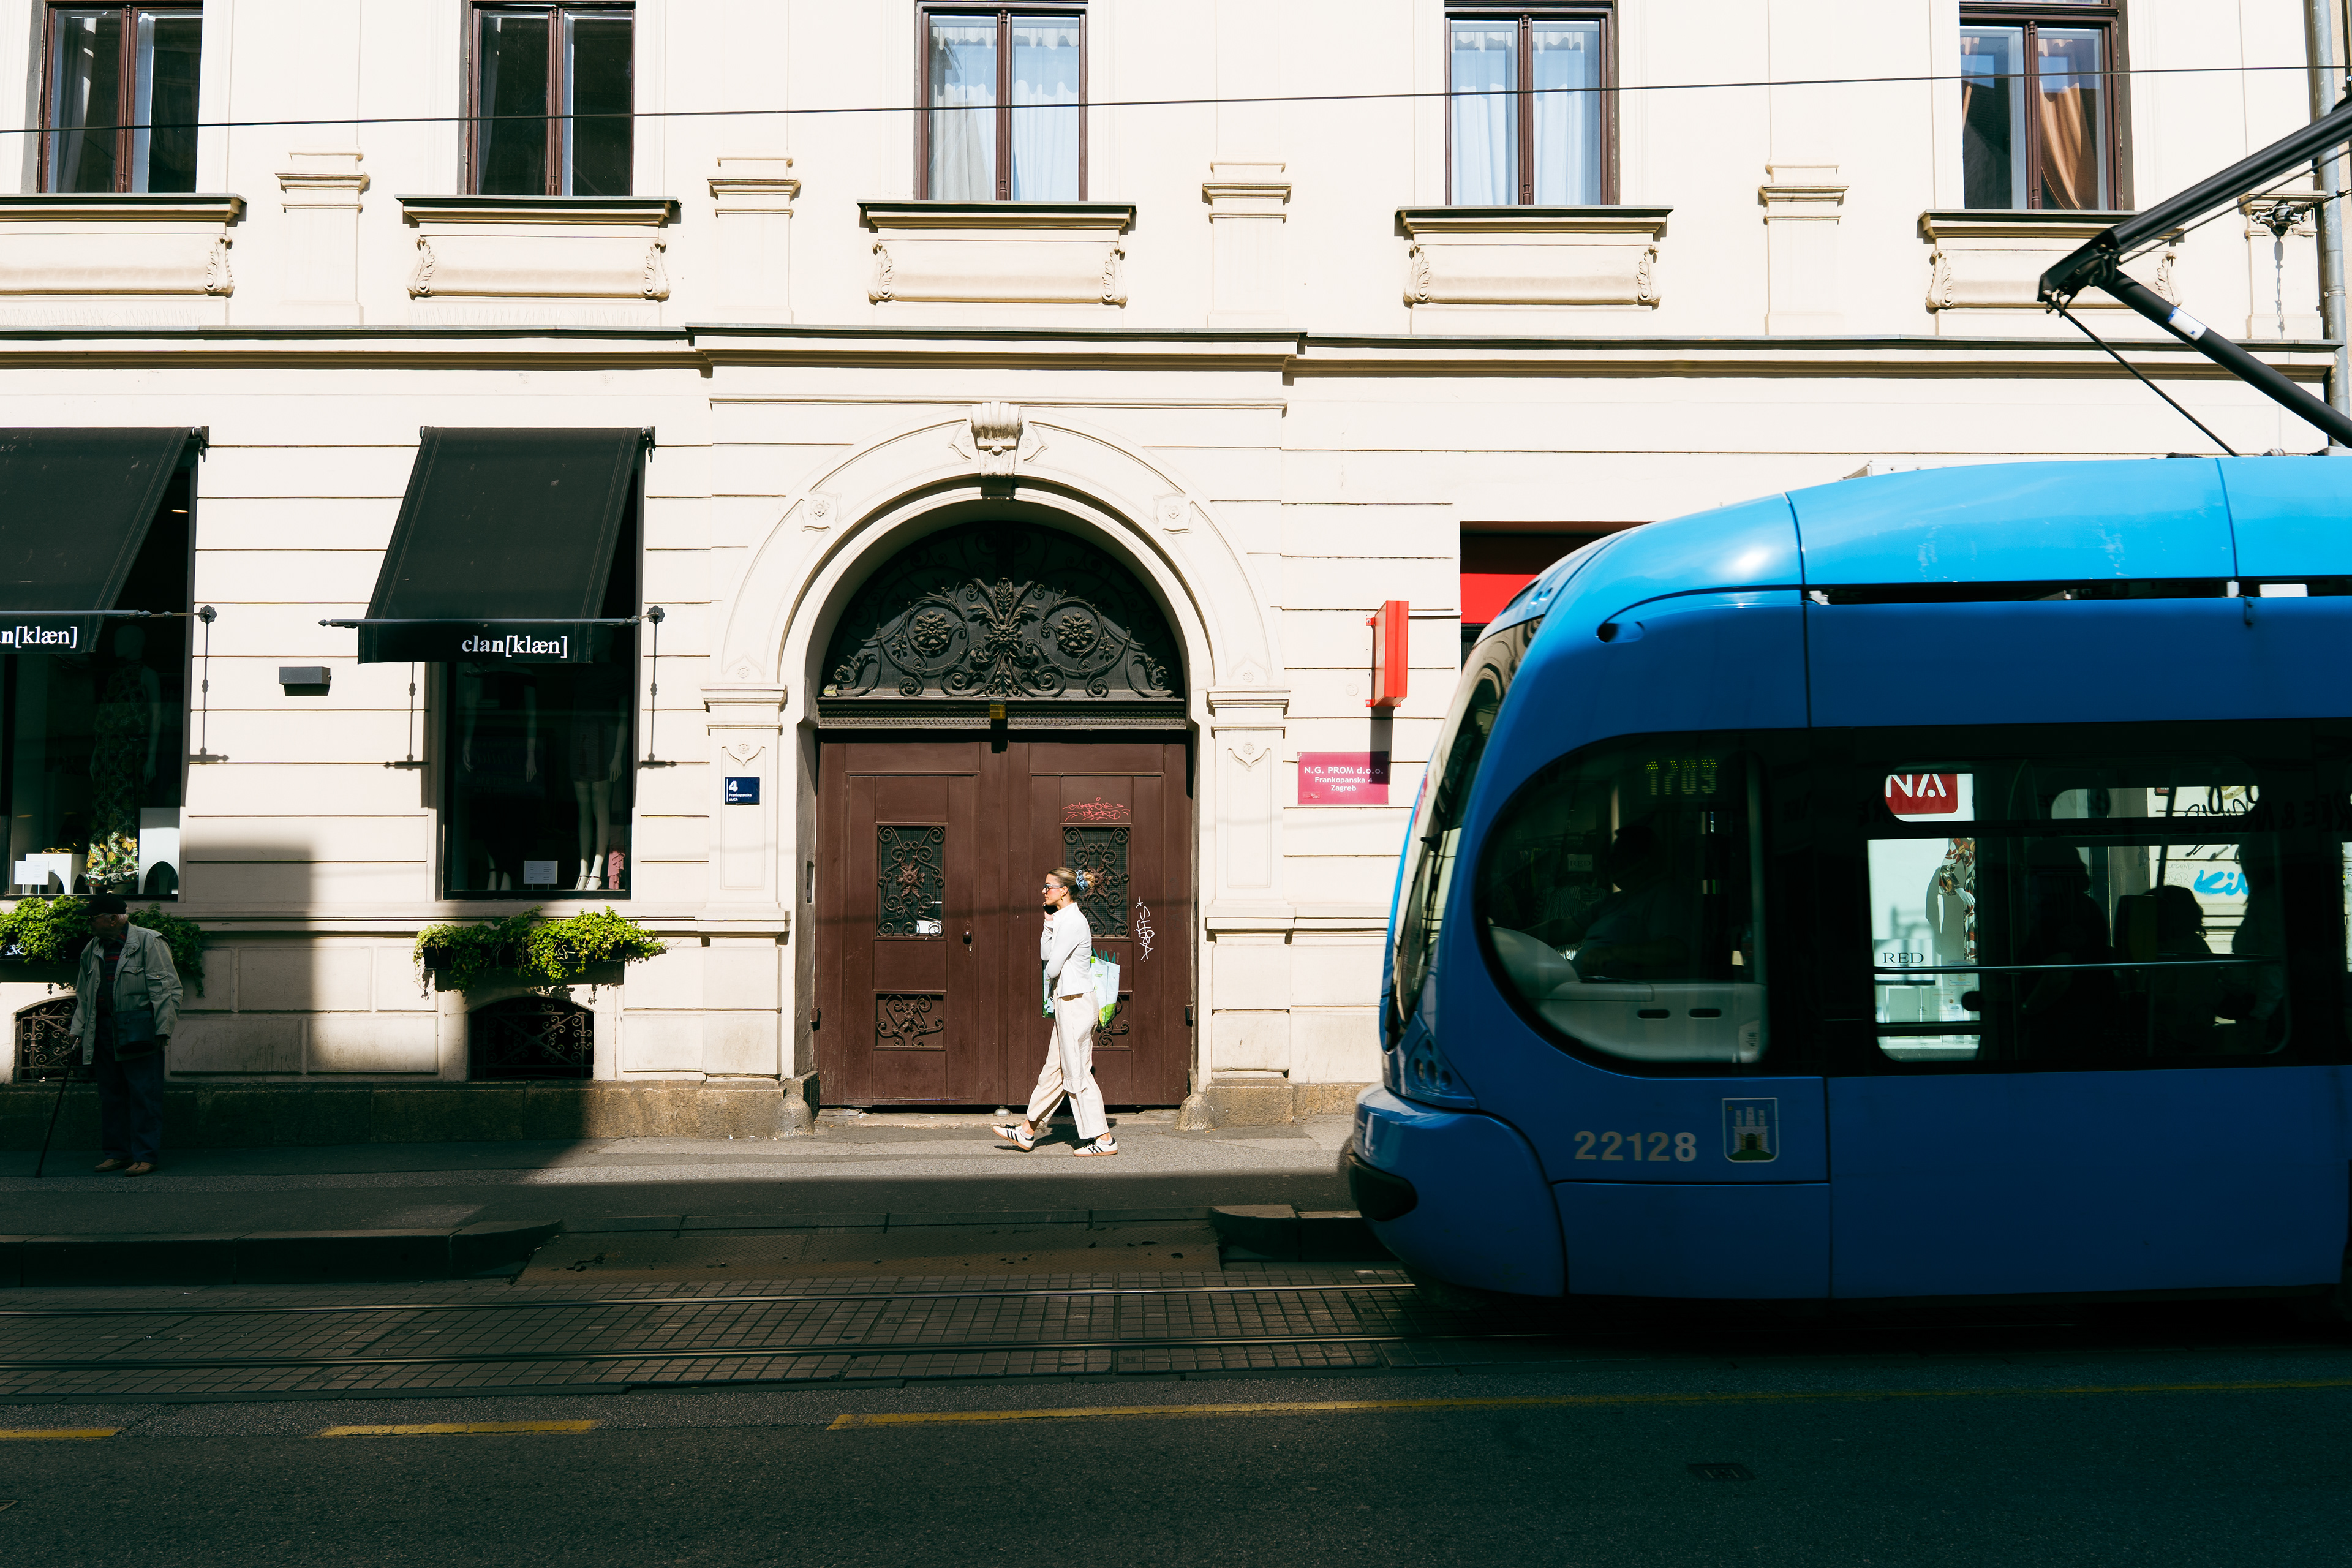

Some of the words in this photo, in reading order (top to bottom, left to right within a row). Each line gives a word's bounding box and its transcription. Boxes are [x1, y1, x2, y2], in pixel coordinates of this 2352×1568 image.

[0, 625, 78, 649] n[klæn]
[462, 635, 568, 658] clan[klæn]
[728, 780, 738, 792] 4
[1883, 952, 1924, 963] RED
[1574, 1131, 1697, 1162] 22128
